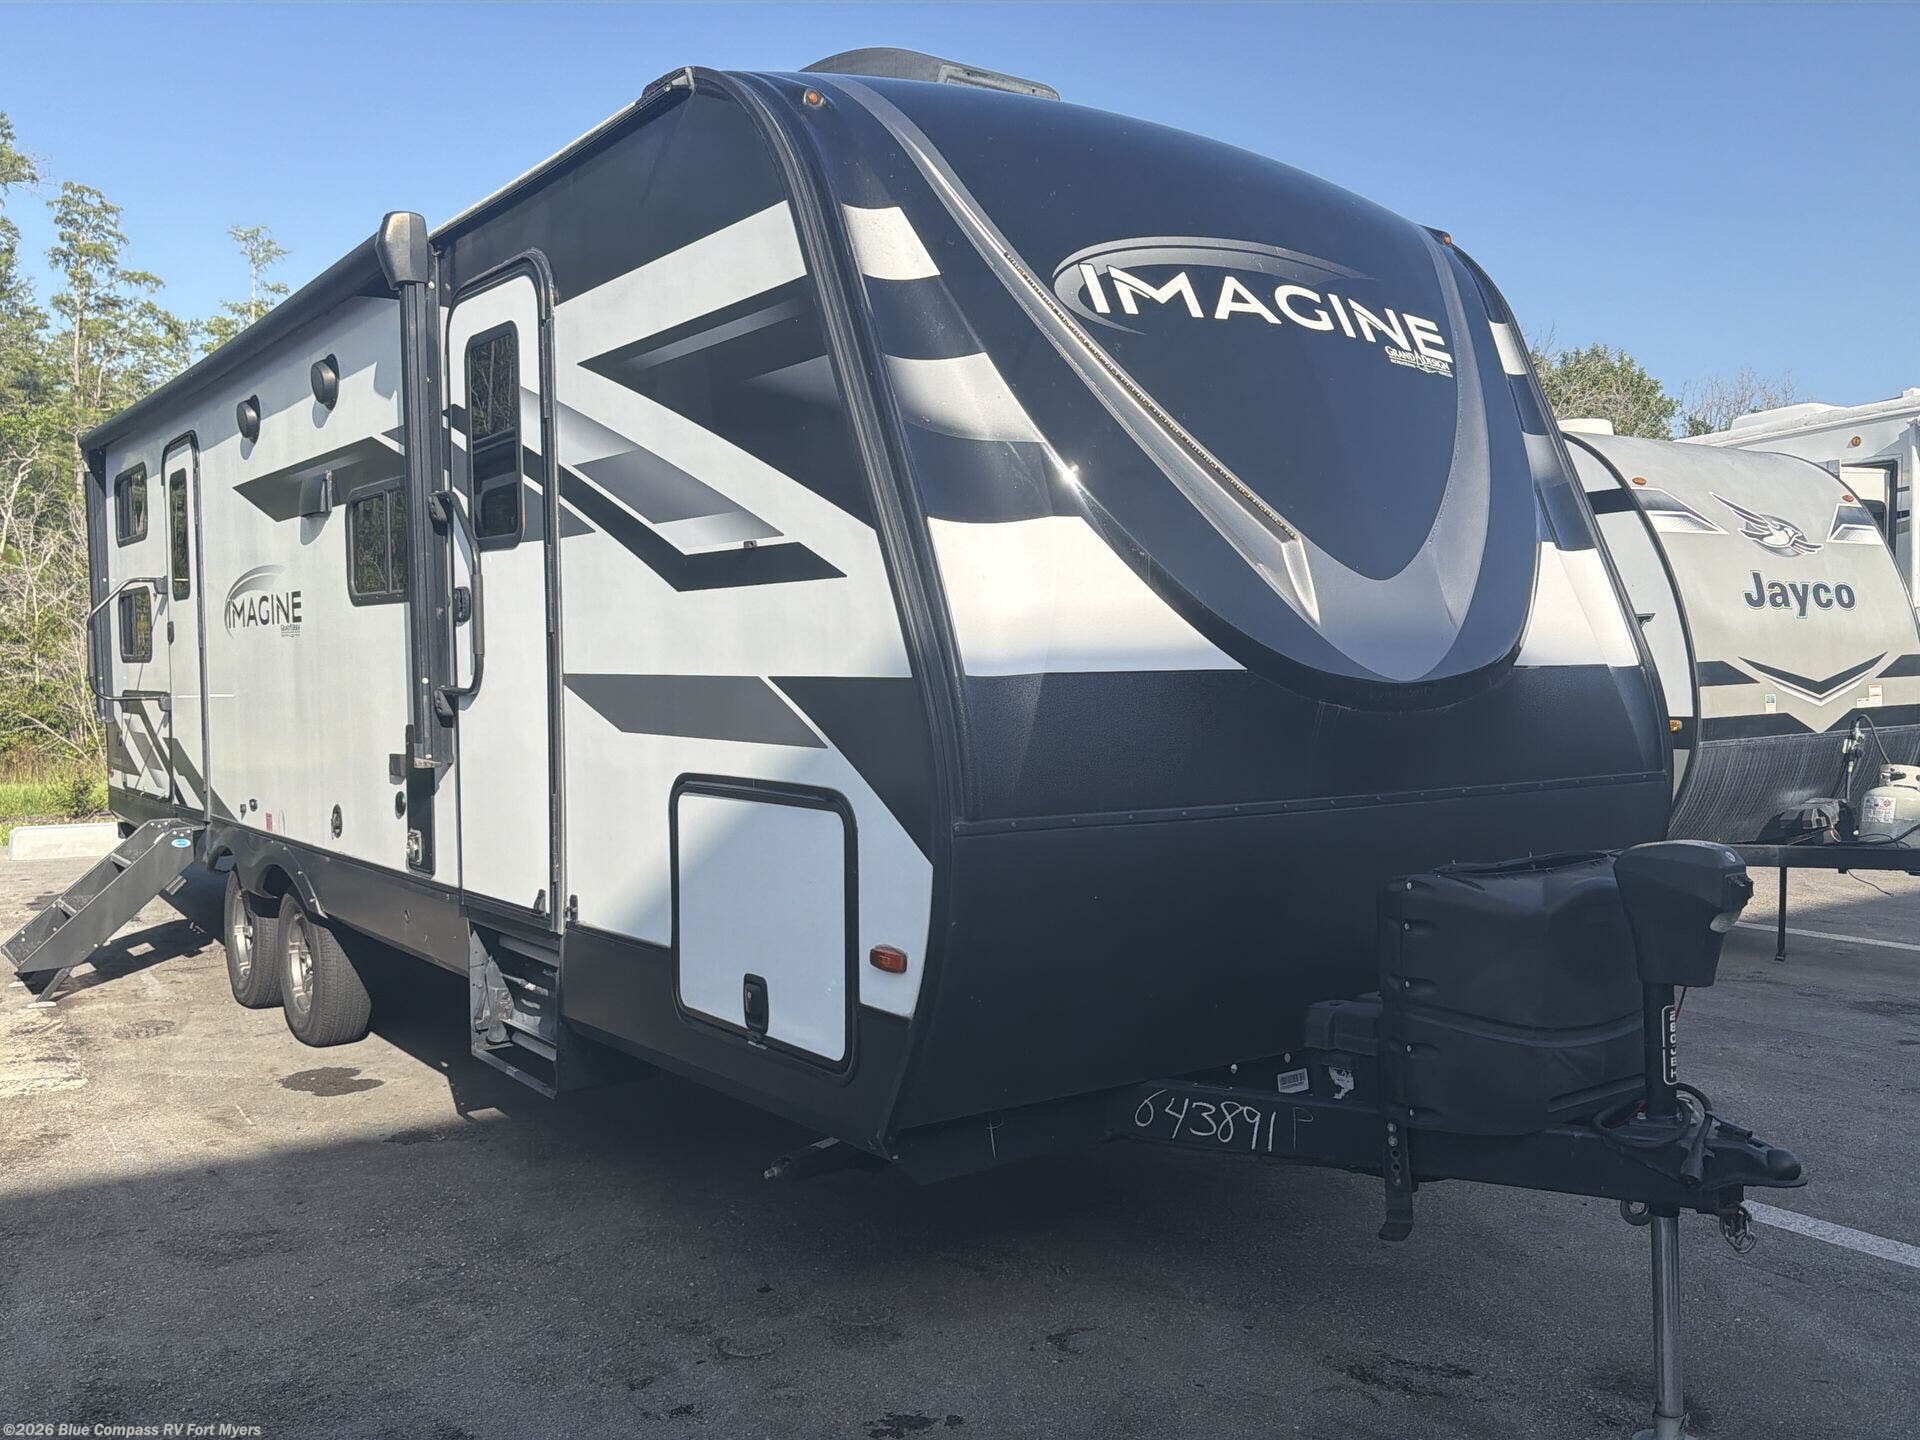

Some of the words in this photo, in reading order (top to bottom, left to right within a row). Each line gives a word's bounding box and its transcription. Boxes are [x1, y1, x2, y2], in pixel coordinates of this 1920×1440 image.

[1079, 263, 1453, 363] IMAGINE
[228, 590, 302, 629] IMAGINE
[1743, 571, 1856, 617] Jayco
[1135, 1089, 1276, 1152] 643891
